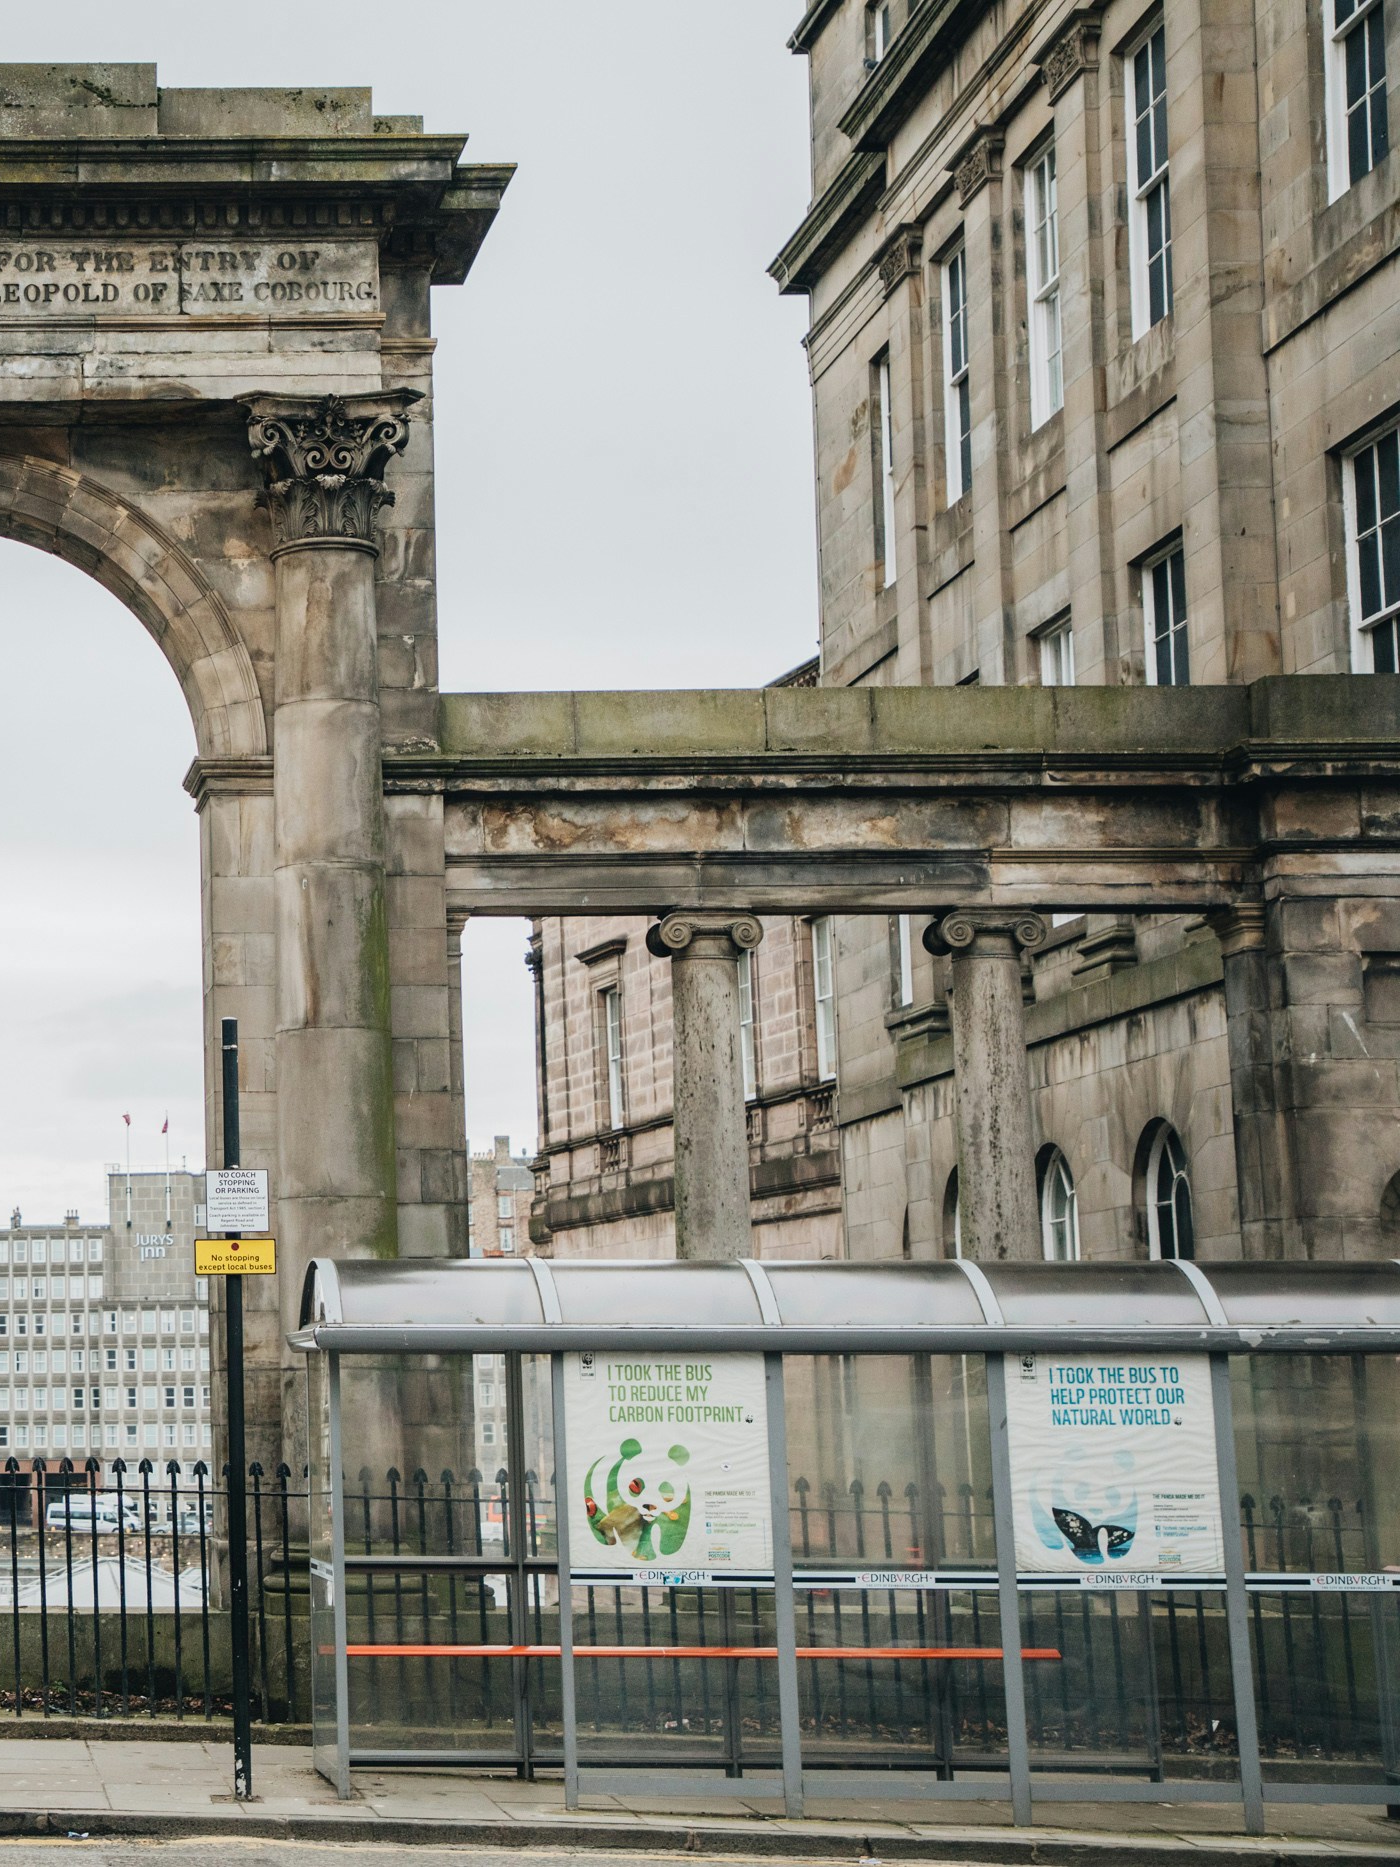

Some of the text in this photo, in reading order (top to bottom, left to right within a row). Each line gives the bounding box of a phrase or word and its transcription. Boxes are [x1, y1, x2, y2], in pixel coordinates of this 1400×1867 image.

[70, 251, 134, 273] THE
[149, 250, 261, 272] ENTRY
[276, 250, 320, 272] OF
[133, 282, 167, 302] OF
[181, 282, 243, 302] SAXE
[254, 281, 377, 301] COBOURG.
[133, 1233, 174, 1248] JURYS
[225, 1254, 260, 1264] stopping
[199, 1264, 225, 1272] except
[607, 1365, 713, 1381] I TOOK THE BUS
[1049, 1367, 1179, 1384] I TOOK THE BUS TO
[608, 1385, 708, 1401] TO REDUCE MY
[1051, 1388, 1185, 1404] HELP PROTECT OUR
[609, 1406, 743, 1422] CARBON FOOTPRINT
[1052, 1409, 1170, 1425] NATURAL WORLD
